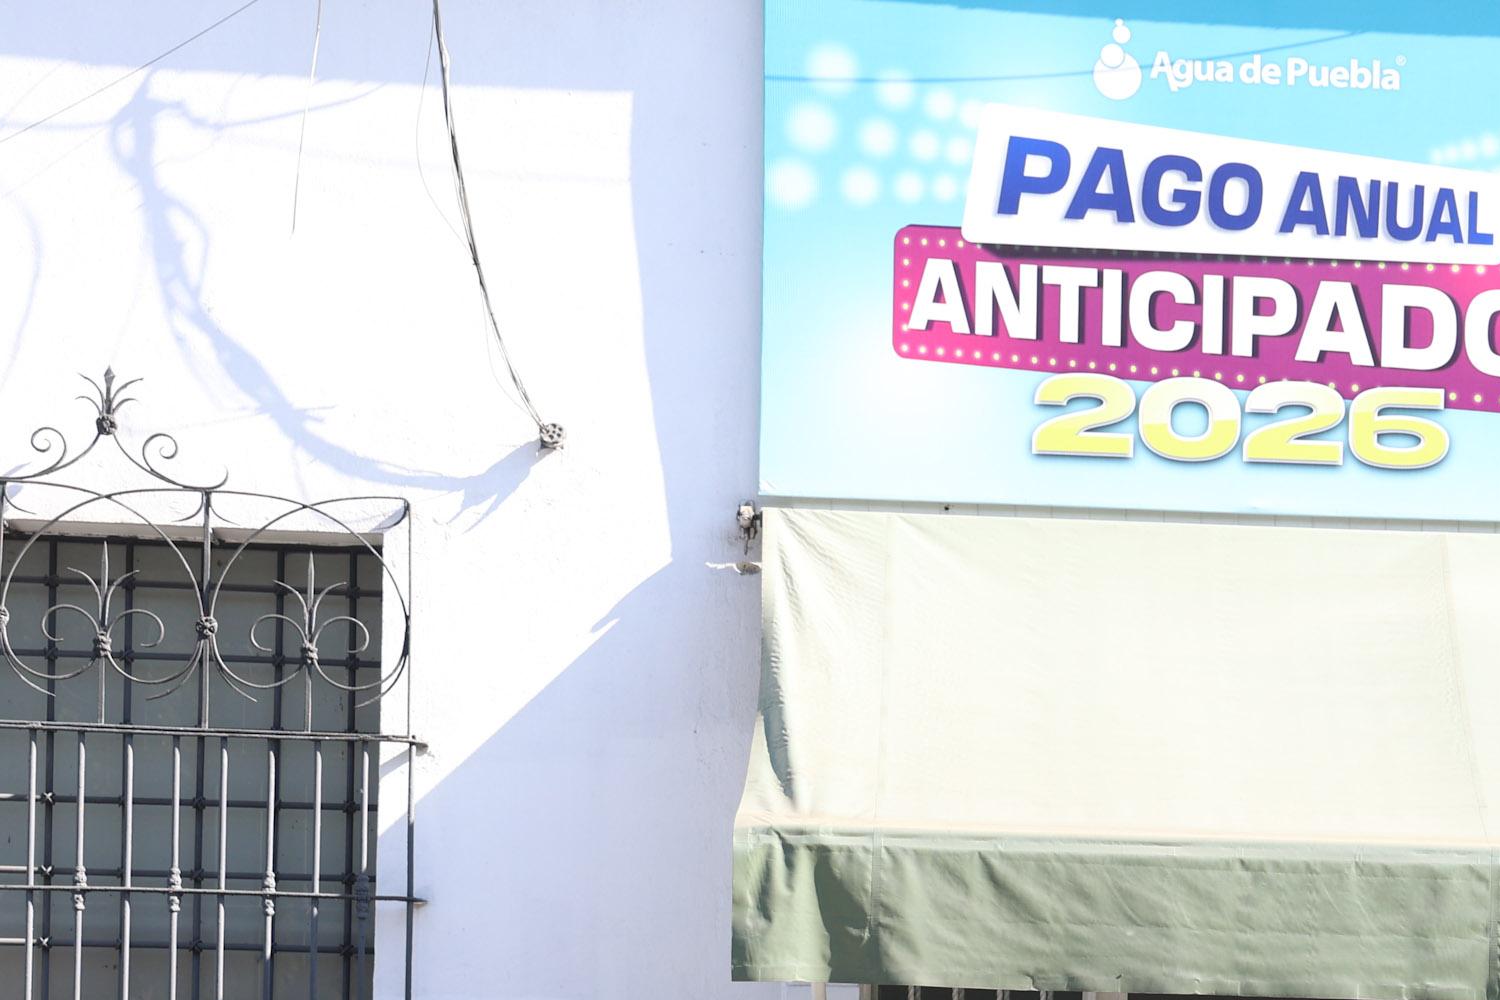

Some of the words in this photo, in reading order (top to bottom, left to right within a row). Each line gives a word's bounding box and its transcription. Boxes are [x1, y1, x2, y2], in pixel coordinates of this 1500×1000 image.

[1150, 50, 1233, 92] Agua
[1239, 54, 1281, 85] de
[1287, 56, 1400, 91] Puebla
[997, 135, 1264, 231] PAGO
[1278, 171, 1494, 246] ANUAL
[1031, 371, 1451, 470] 2026
